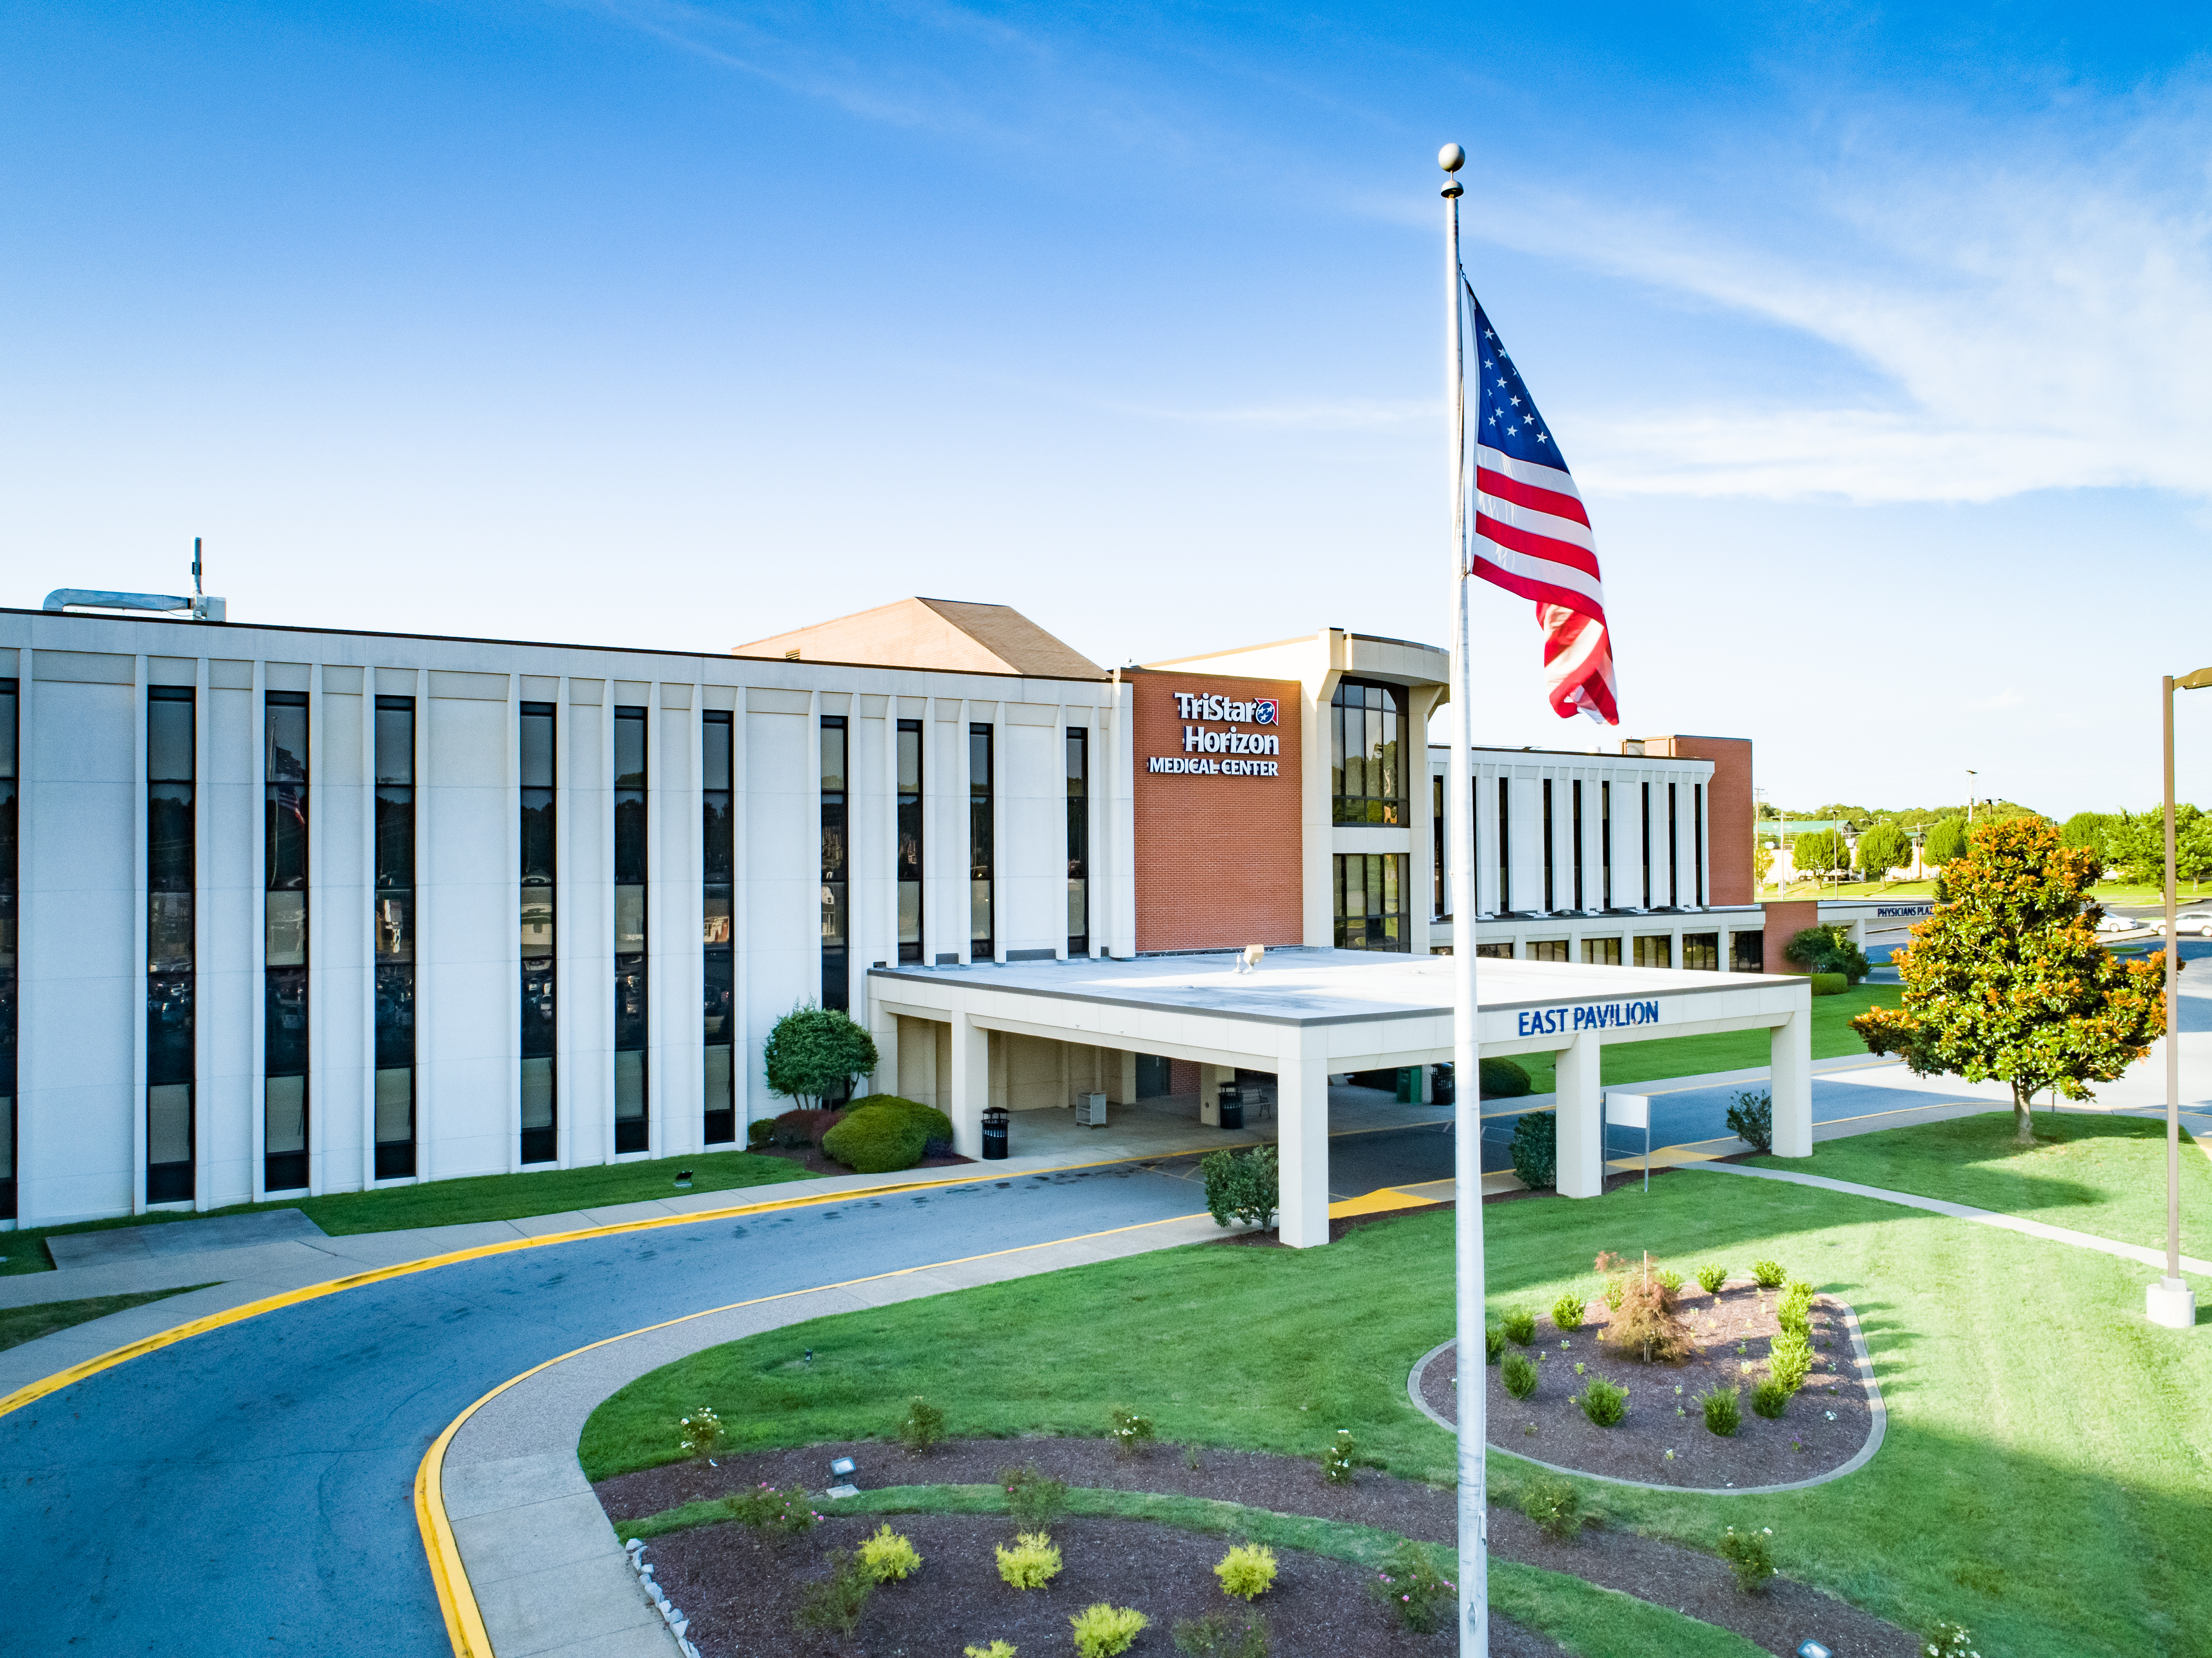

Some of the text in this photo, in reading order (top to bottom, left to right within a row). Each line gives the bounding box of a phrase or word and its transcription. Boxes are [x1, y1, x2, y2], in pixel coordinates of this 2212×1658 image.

[1174, 692, 1256, 722] TriStar
[1184, 726, 1279, 755] Horizon
[1149, 757, 1279, 776] MEDICAL CENTER
[1878, 906, 1935, 917] PHYSICIANS PLAZ
[1519, 1001, 1658, 1036] EAST PAVILION
